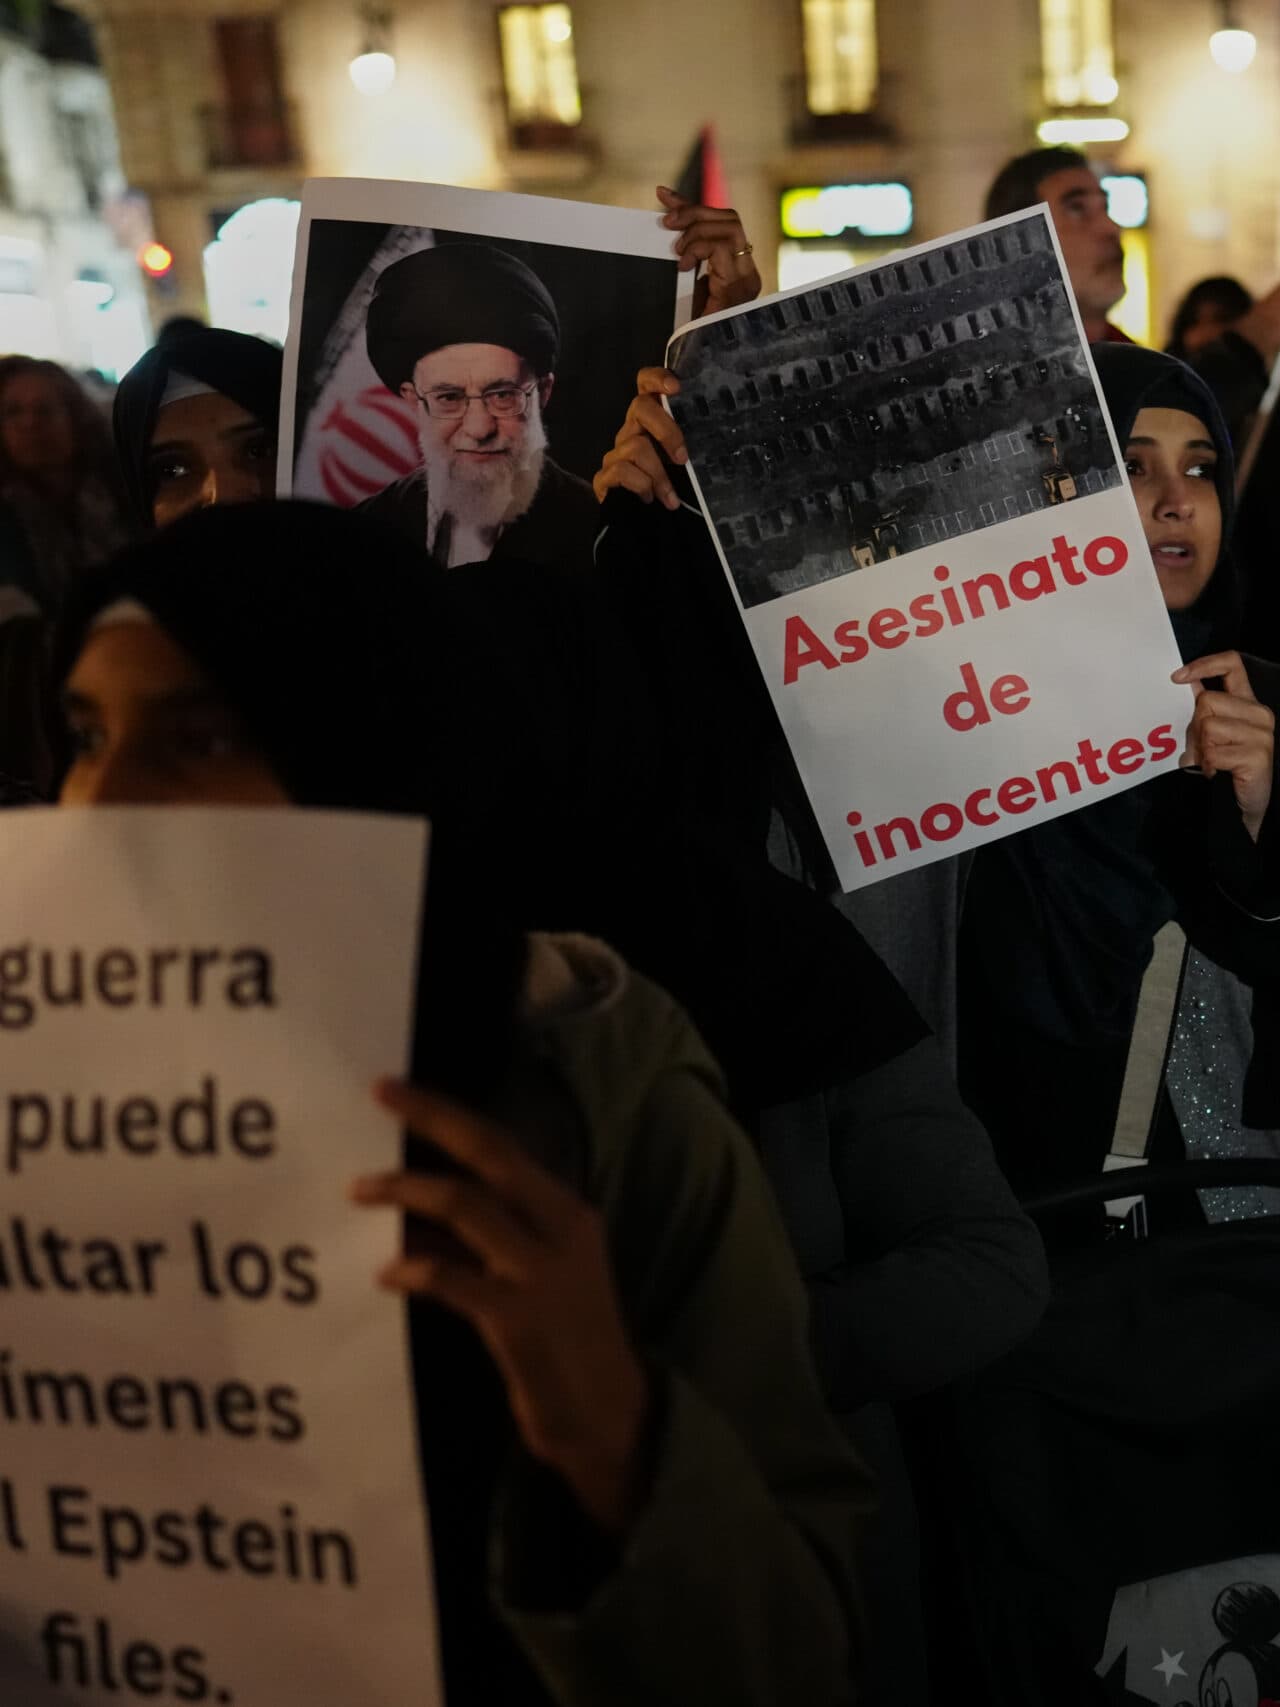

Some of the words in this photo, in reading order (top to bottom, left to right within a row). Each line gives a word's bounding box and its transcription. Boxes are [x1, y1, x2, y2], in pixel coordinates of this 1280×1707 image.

[783, 534, 1129, 685] Asesinato
[942, 662, 1032, 732] de
[845, 723, 1178, 867] inocentes
[0, 941, 279, 1032] guerra
[4, 1075, 278, 1177] puede
[189, 1218, 321, 1309] los
[45, 1482, 359, 1590] Epstein
[40, 1609, 235, 1707] files.
